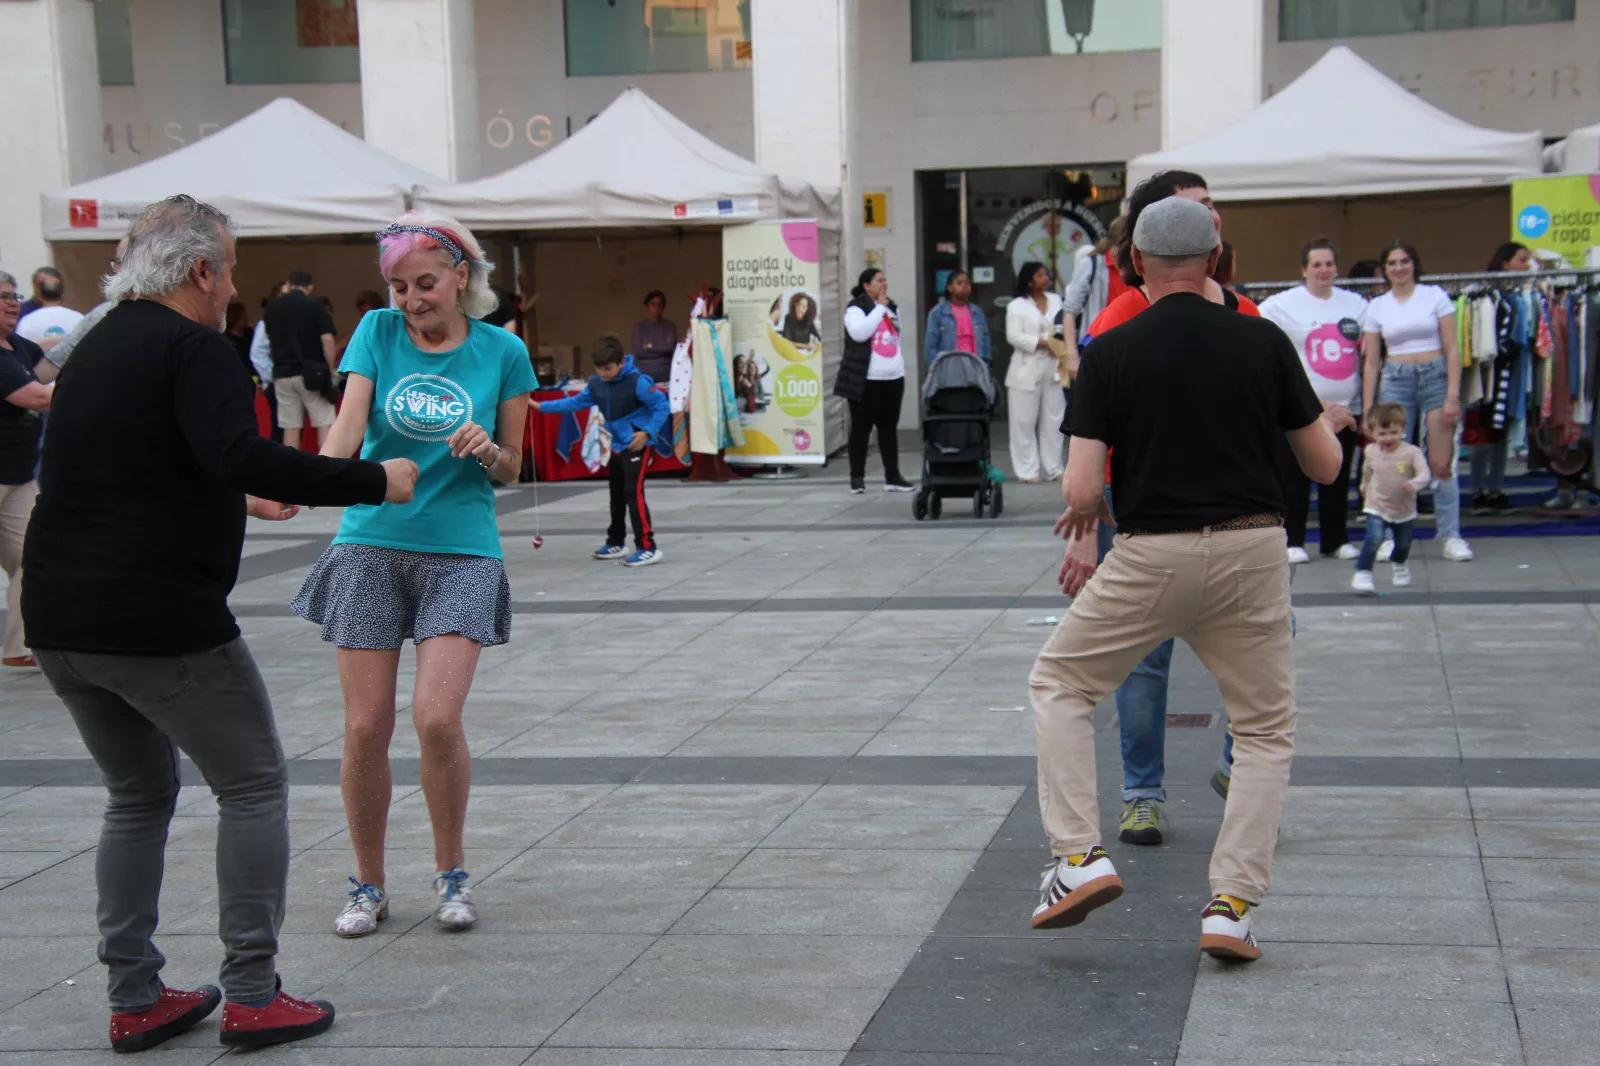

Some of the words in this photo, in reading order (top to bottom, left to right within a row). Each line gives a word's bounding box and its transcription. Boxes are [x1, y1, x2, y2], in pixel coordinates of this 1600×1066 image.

[1552, 228, 1591, 243] ropa
[727, 256, 780, 273] acogida
[785, 257, 793, 272] y
[727, 272, 806, 291] diagnóstico
[777, 379, 819, 398] 1.000
[393, 396, 465, 416] SWING
